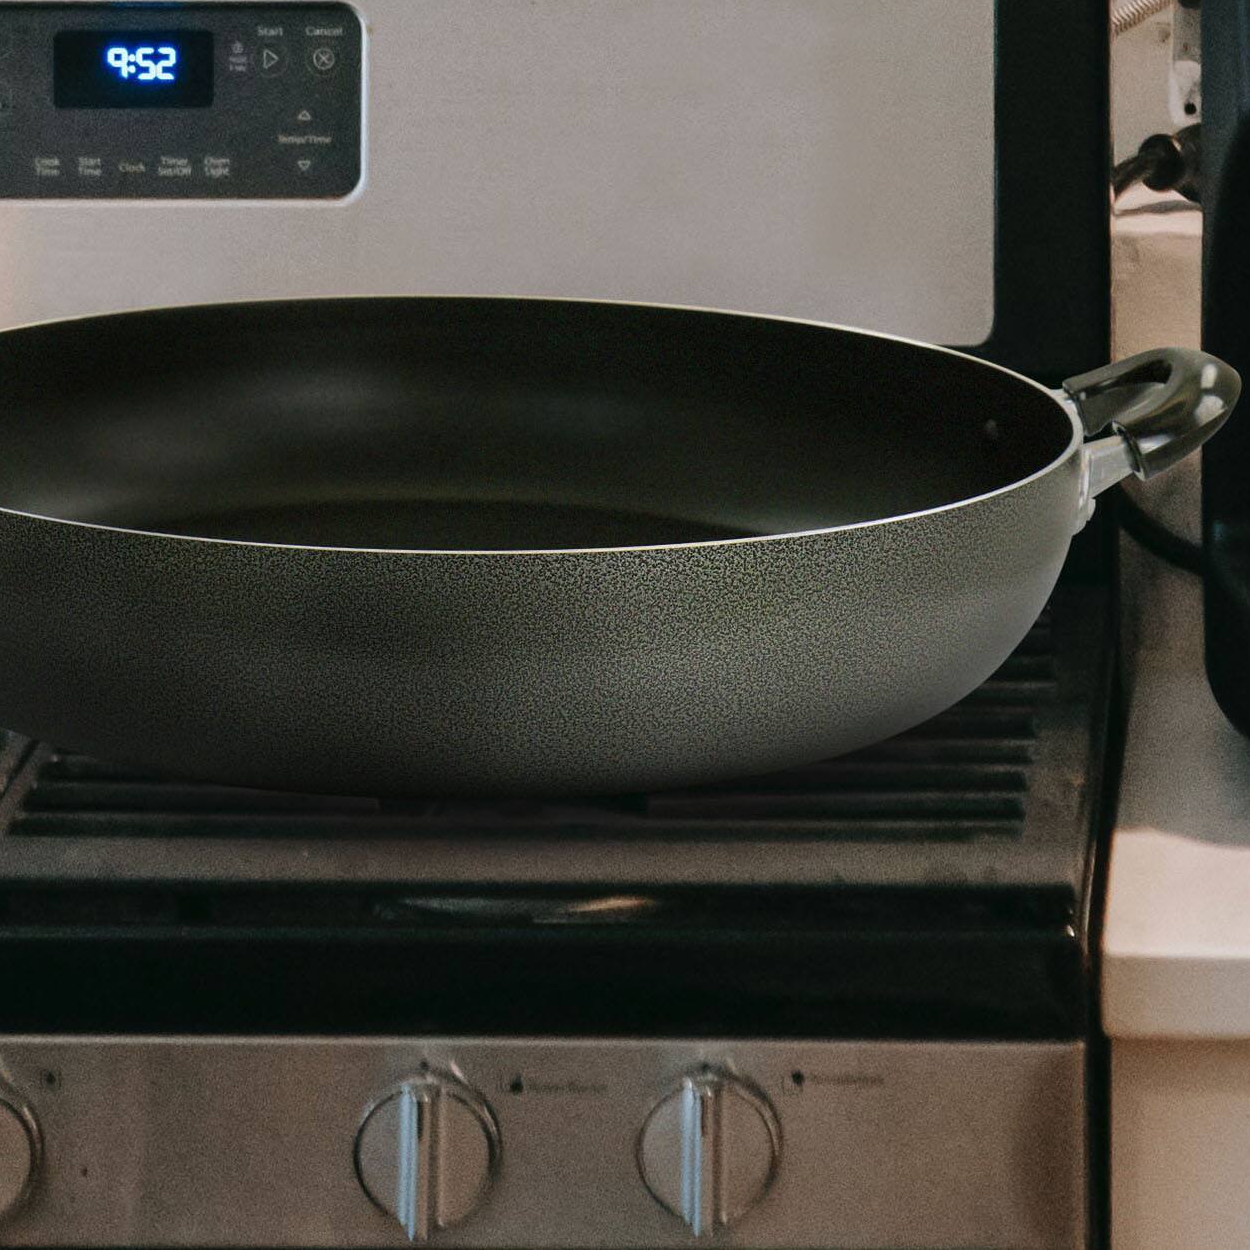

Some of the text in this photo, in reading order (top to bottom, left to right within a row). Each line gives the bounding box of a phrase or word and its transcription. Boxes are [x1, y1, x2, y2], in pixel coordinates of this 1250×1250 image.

[257, 26, 283, 37] Start
[305, 26, 343, 37] Cancel
[107, 47, 177, 81] 9:52
